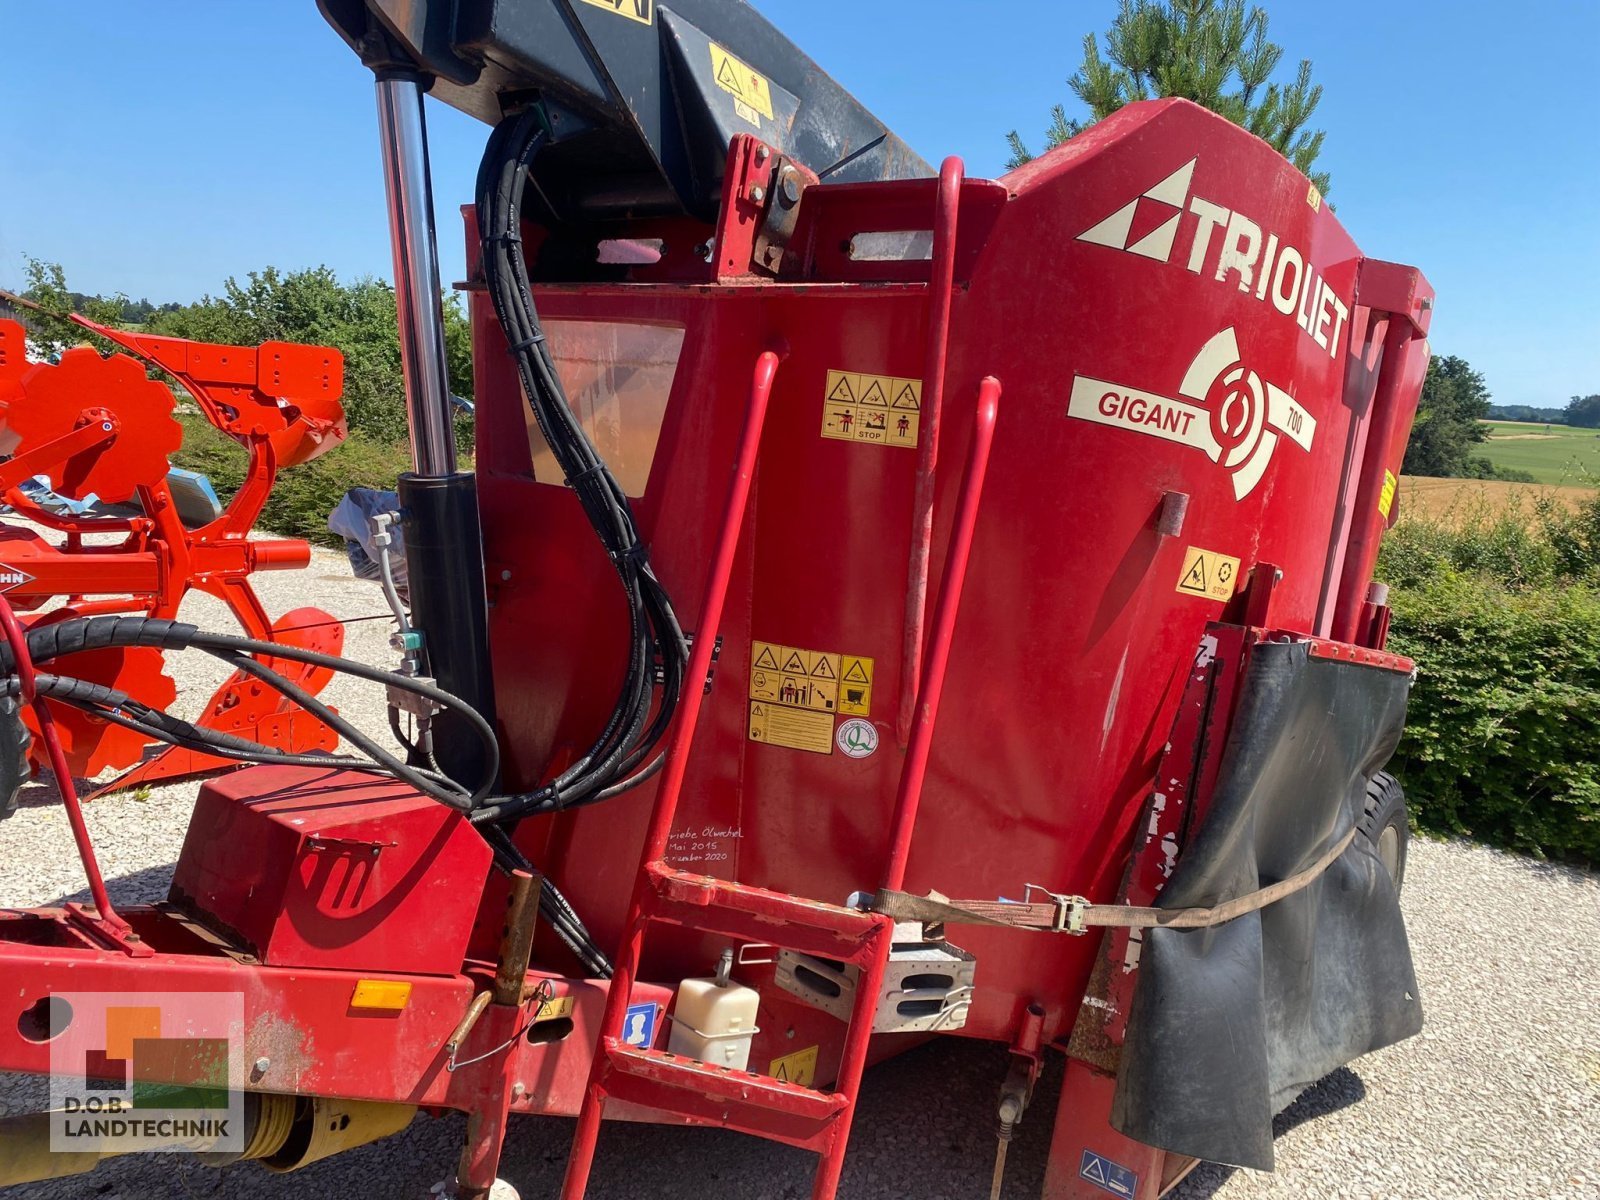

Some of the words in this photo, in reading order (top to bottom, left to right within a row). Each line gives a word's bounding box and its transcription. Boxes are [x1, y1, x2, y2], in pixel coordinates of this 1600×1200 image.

[1187, 196, 1349, 360] TRIOLIET
[1098, 391, 1196, 436] GIGANT
[1286, 406, 1303, 435] 700
[858, 430, 881, 440] STOP
[1211, 585, 1229, 596] STOP
[299, 756, 337, 764] HANSA-FLEX
[668, 827, 698, 839] riebe
[669, 842, 686, 851] Mai
[691, 841, 718, 850] 2015
[705, 852, 728, 861] 2020
